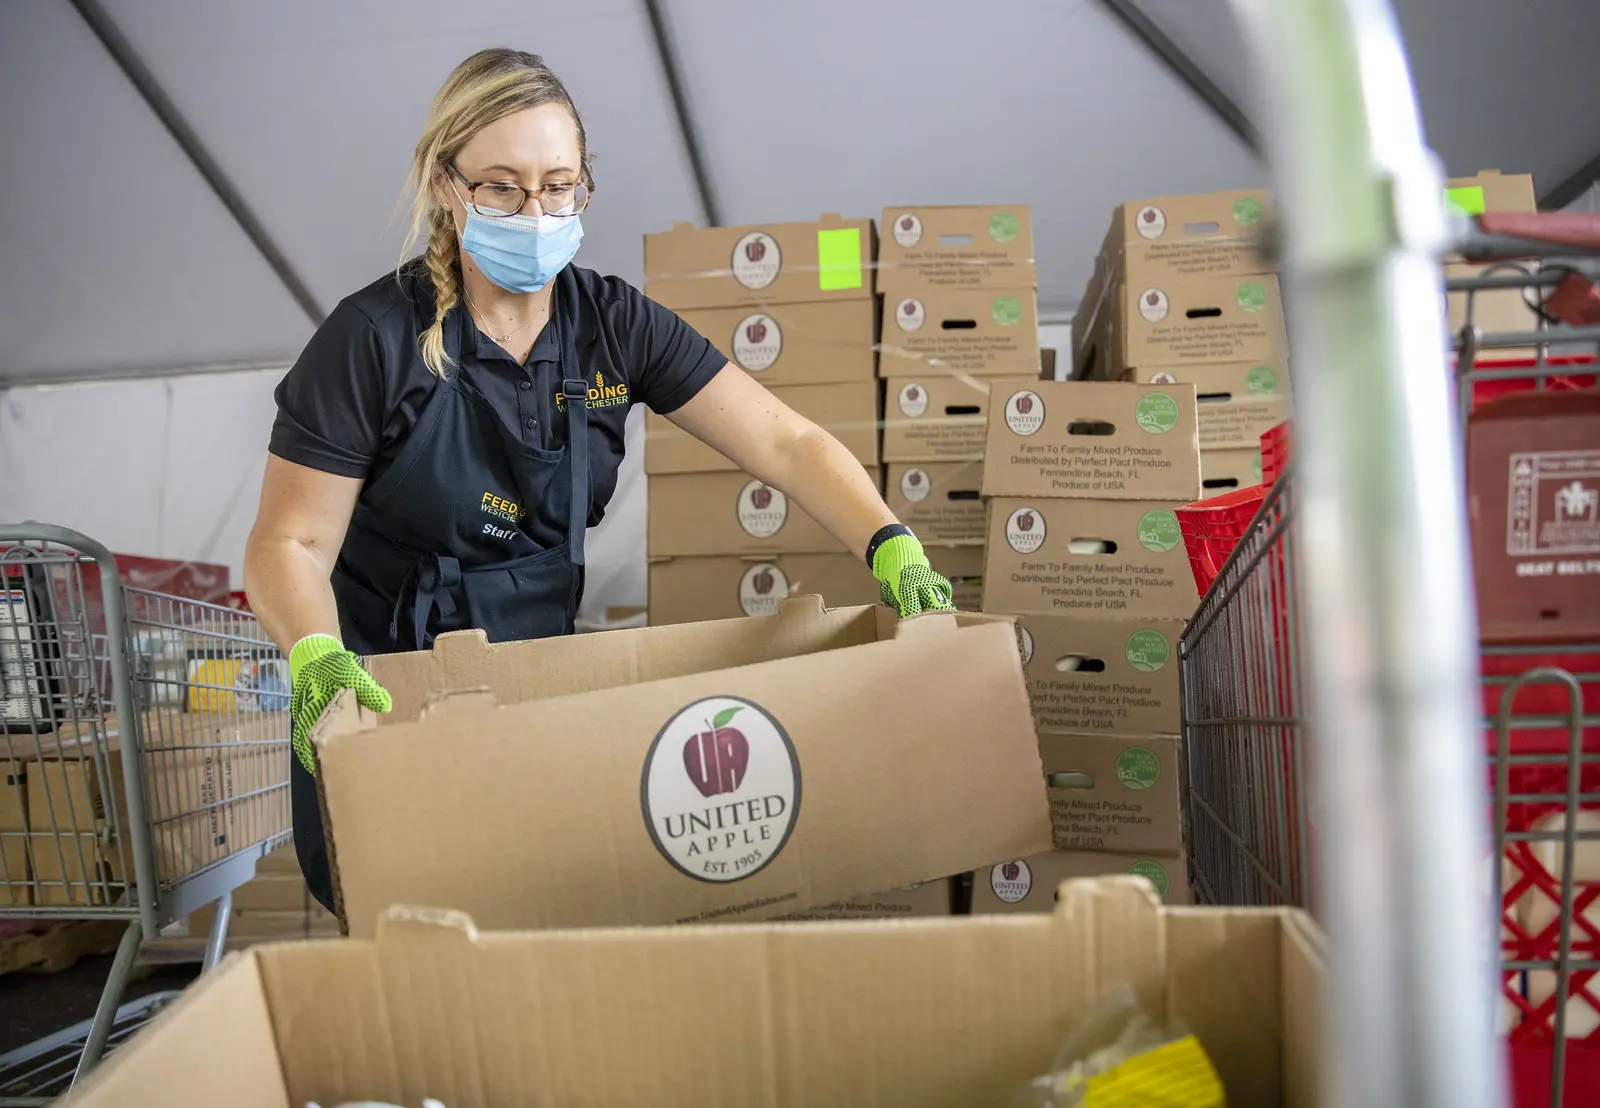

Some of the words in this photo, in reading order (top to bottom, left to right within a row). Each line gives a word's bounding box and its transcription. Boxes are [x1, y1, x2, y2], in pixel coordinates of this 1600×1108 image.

[555, 383, 628, 405] FDING
[558, 395, 629, 413] WCHESTER
[1020, 444, 1044, 453] Farm
[1048, 445, 1058, 454] To
[1061, 445, 1091, 456] Family
[1094, 446, 1120, 455] Mixed
[1123, 446, 1162, 456] Produce
[1010, 456, 1058, 465] Distributed
[1061, 456, 1071, 468] by
[1075, 457, 1107, 467] Perfect
[1110, 458, 1129, 467] Pact
[1132, 458, 1172, 468] Produce
[1040, 468, 1091, 478] Fernandina
[1094, 469, 1125, 480] Beach,
[1128, 470, 1140, 479] FL
[1052, 480, 1090, 490] Produce
[1093, 481, 1102, 490] of
[1103, 482, 1125, 490] USA
[482, 524, 519, 540] Staff
[1022, 562, 1046, 571] Farm
[1048, 563, 1060, 572] To
[1063, 563, 1093, 574] Family
[1095, 564, 1123, 573] Mixed
[1125, 565, 1164, 575] Produce
[1011, 573, 1060, 584] Distributed
[1062, 574, 1074, 586] by
[1076, 575, 1109, 585] Perfect
[1111, 576, 1132, 585] Pact
[1135, 577, 1174, 587] Produce
[1041, 586, 1093, 597] Fernandina
[1095, 588, 1128, 598] Beach,
[1130, 589, 1143, 598] FL
[1053, 599, 1092, 609] Produce
[1094, 600, 1103, 609] of
[1106, 600, 1127, 610] USA
[1035, 681, 1047, 689] To
[1050, 682, 1080, 693] Family
[1083, 682, 1110, 692] Mixed
[1113, 684, 1152, 695] Produce
[1050, 694, 1061, 704] by
[1063, 694, 1096, 704] Perfect
[1099, 695, 1119, 705] Pact
[1122, 697, 1161, 708] Produce
[1082, 707, 1114, 718] Beach,
[1117, 708, 1130, 718] FL
[1040, 717, 1078, 728] Produce
[1081, 719, 1090, 728] of
[1092, 720, 1114, 730] USA
[1072, 800, 1100, 810] Mixed
[1103, 801, 1142, 812] Produce
[663, 795, 786, 839] UNITED
[1089, 813, 1110, 822] Pact
[1112, 814, 1152, 825] Produce
[1108, 825, 1120, 836] FL
[687, 824, 771, 857] APPLE
[1070, 836, 1080, 845] of
[1082, 837, 1104, 847] USA
[703, 860, 730, 873] EST.
[734, 848, 763, 872] 1905
[995, 882, 1028, 890] UNITED
[846, 902, 872, 912] Mixed
[875, 903, 912, 912] Produce
